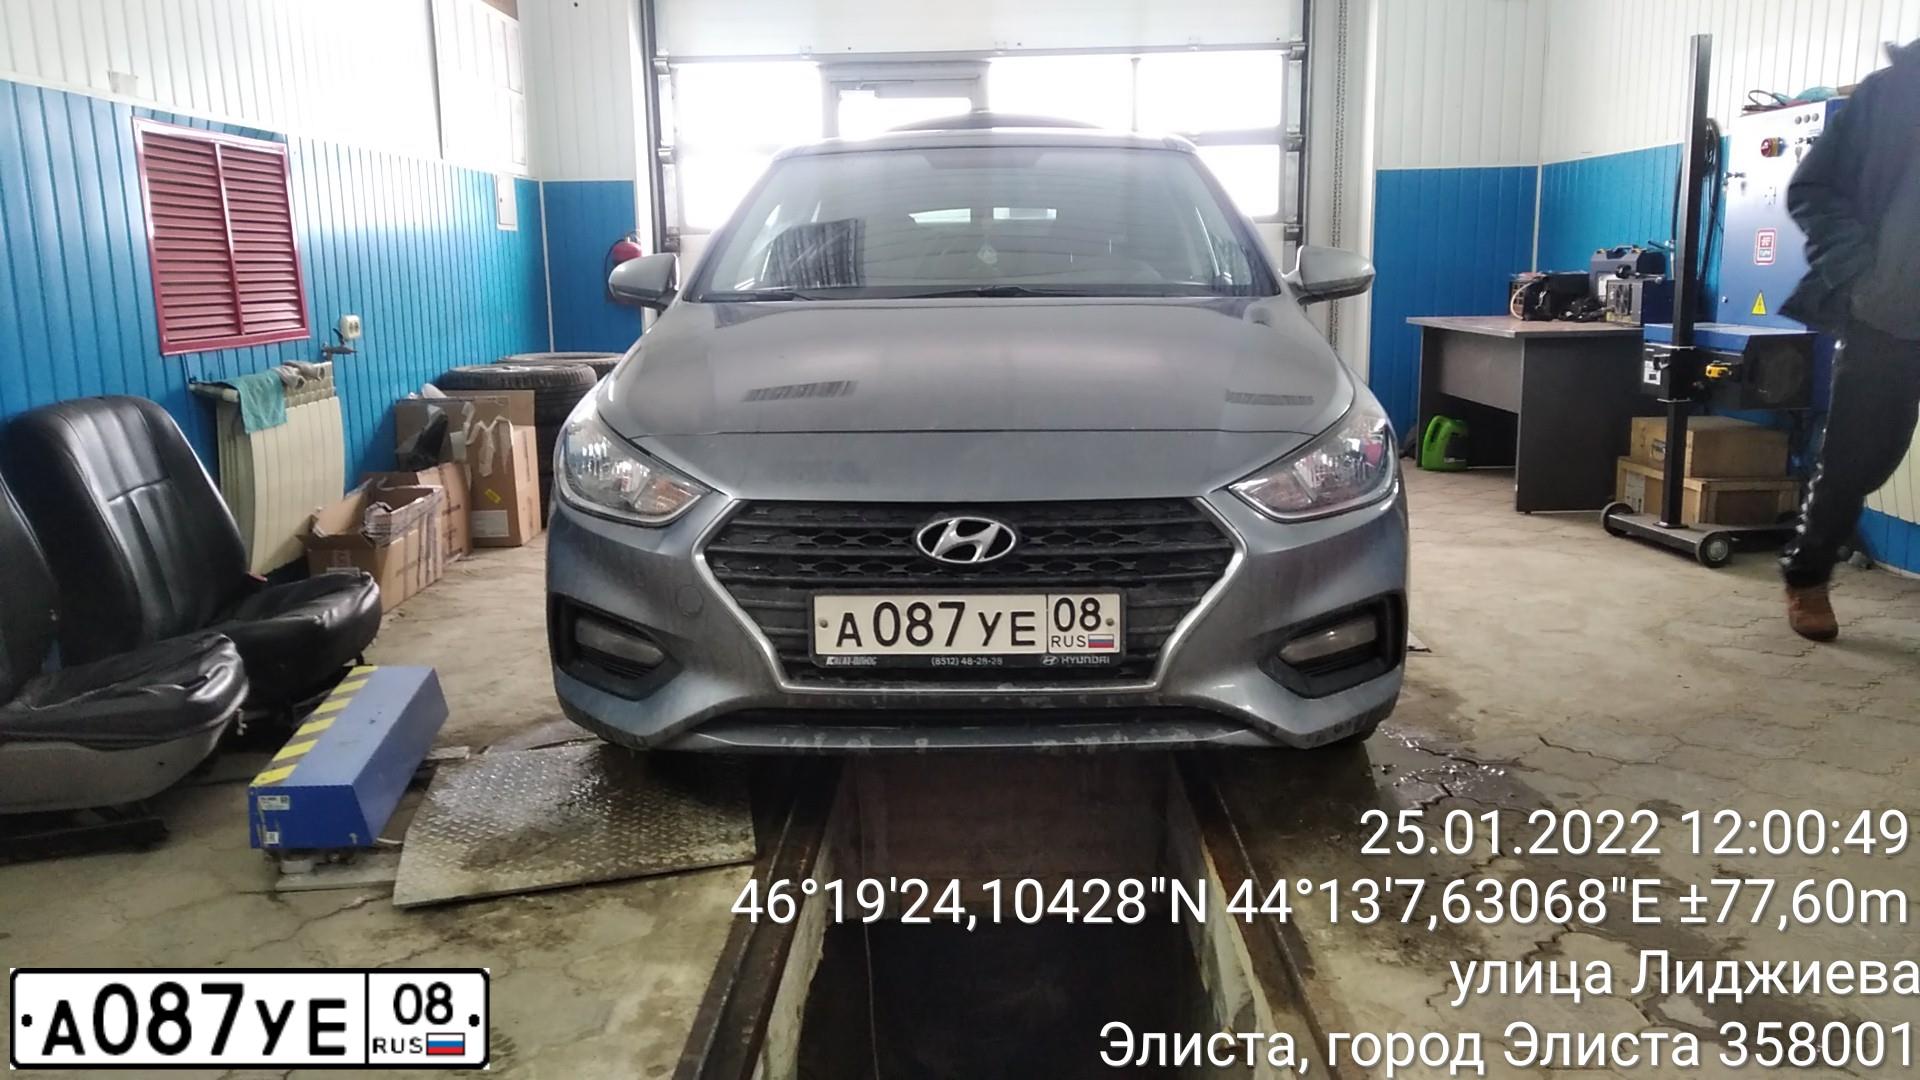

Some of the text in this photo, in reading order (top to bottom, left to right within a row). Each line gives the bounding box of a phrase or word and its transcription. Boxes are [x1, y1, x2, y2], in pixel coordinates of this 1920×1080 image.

[836, 601, 1036, 648] А087УЕ
[1053, 597, 1102, 632] 08
[1051, 634, 1087, 648] RUS
[1060, 655, 1111, 665] HYUNDAI
